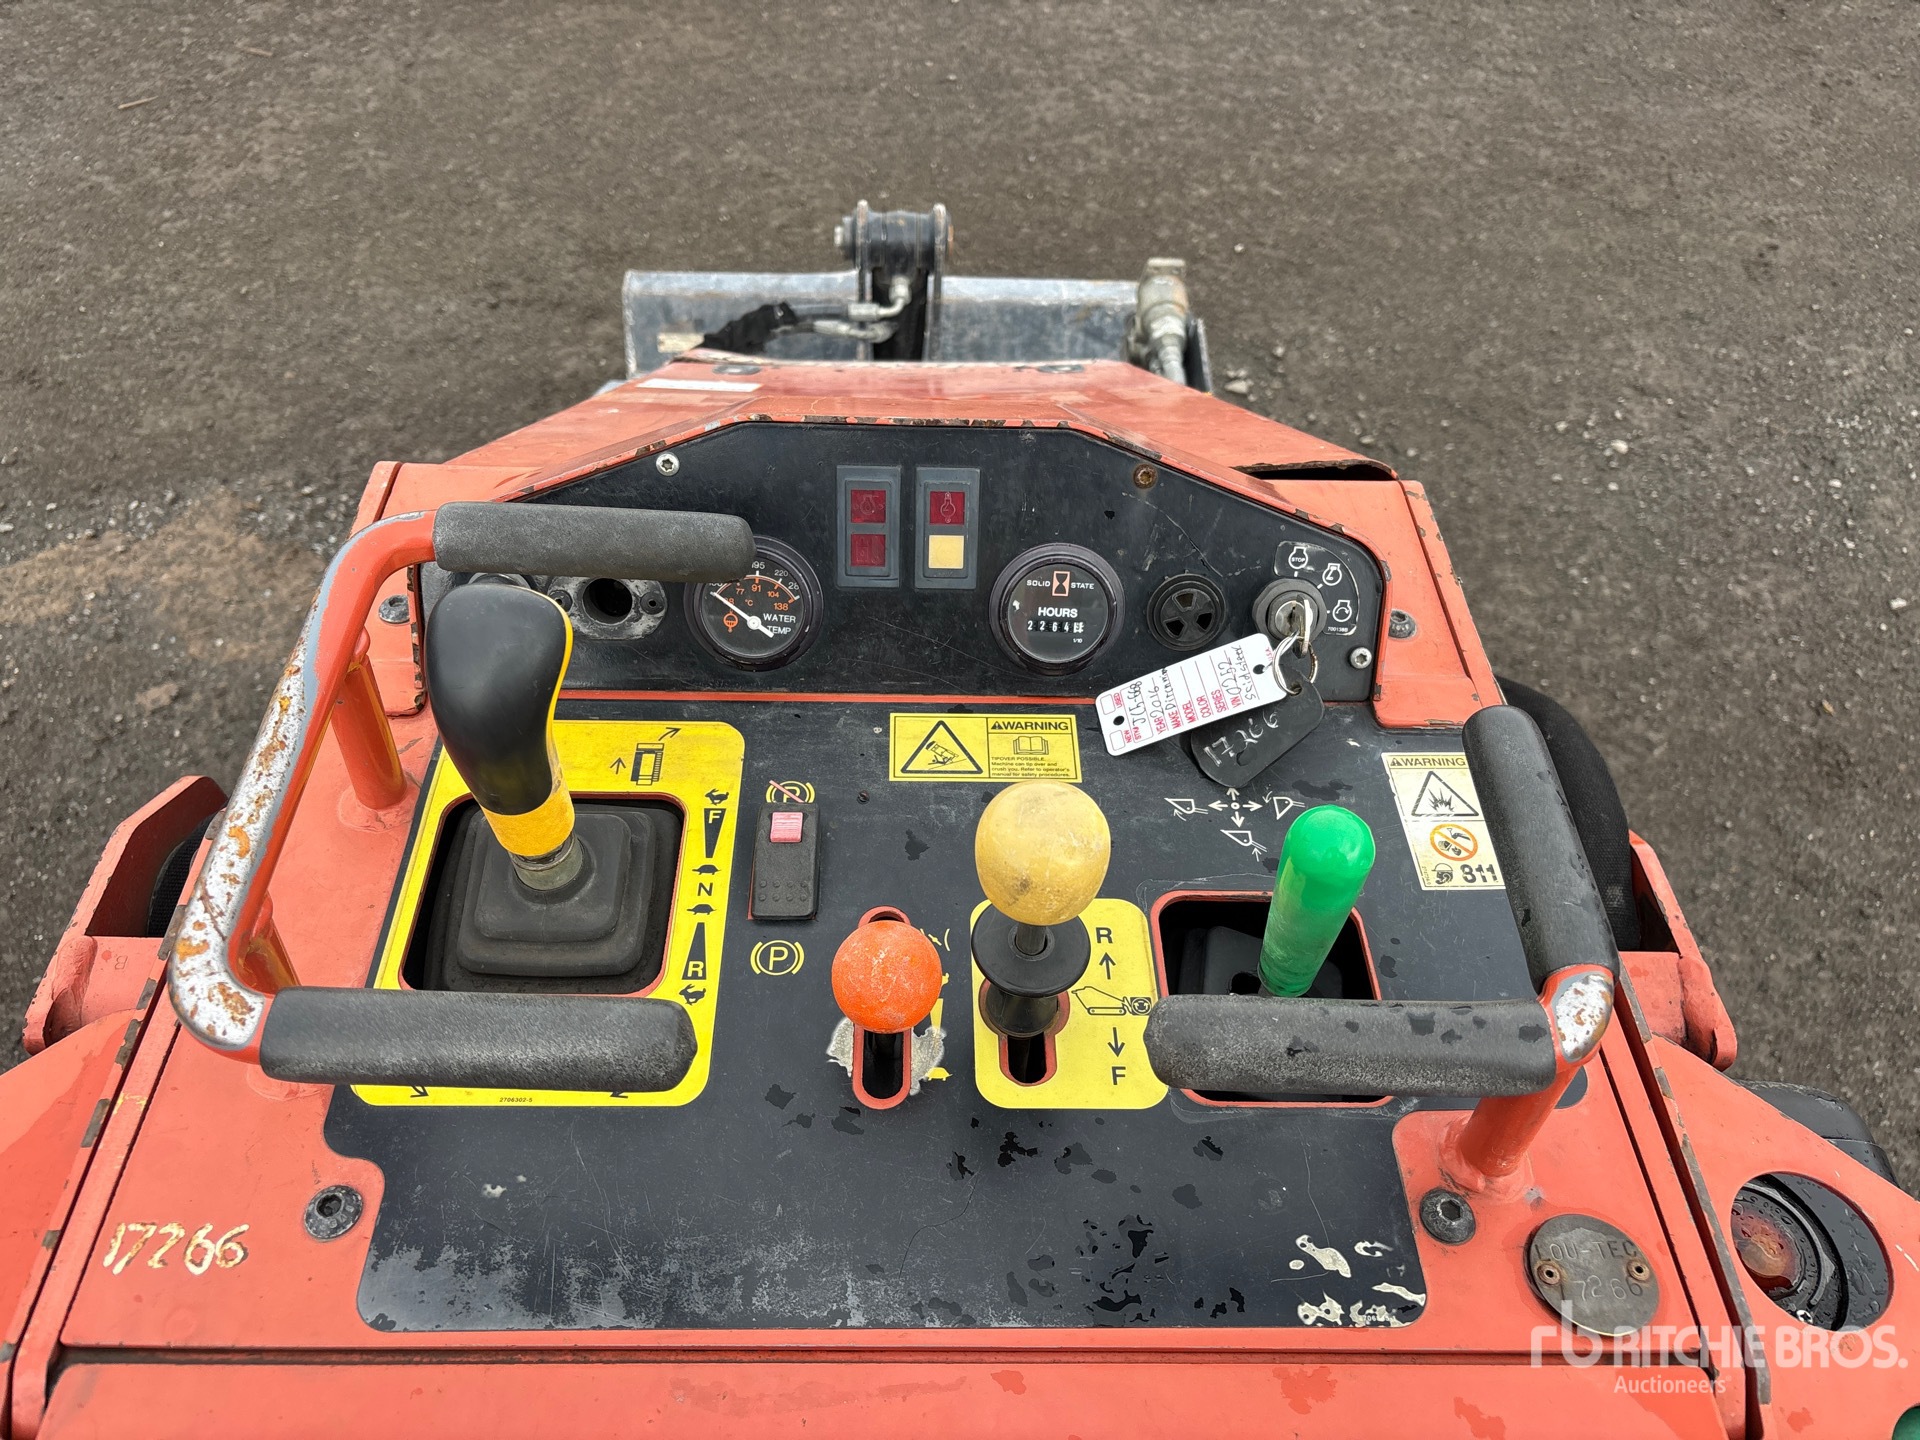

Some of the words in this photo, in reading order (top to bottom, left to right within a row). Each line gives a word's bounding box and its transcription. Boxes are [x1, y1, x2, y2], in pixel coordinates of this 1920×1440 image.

[774, 569, 789, 577] 220
[751, 584, 761, 592] 91
[1070, 582, 1095, 590] STATE
[767, 590, 780, 598] 104
[773, 602, 789, 611] 138
[1037, 606, 1078, 618] HOURS
[763, 613, 797, 623] WATER
[767, 626, 792, 634] TEMP
[1113, 692, 1123, 708] USED
[1148, 686, 1165, 718] 2016
[1196, 694, 1212, 718] COLOR
[1210, 689, 1227, 713] SERIES
[1229, 696, 1241, 709] VIN
[1168, 709, 1182, 729] MAKE
[1182, 700, 1197, 724] MODEL
[1002, 721, 1069, 731] WARNING
[1153, 716, 1167, 735] YEAR
[1123, 729, 1132, 743] NEW
[1401, 757, 1466, 767] WARNING
[708, 810, 723, 824] F
[697, 882, 713, 896] N
[1095, 927, 1113, 944] R
[687, 962, 704, 977] R
[1111, 1066, 1126, 1085] F
[103, 1222, 249, 1275] 17266
[1534, 1240, 1638, 1261] LOU-TEC
